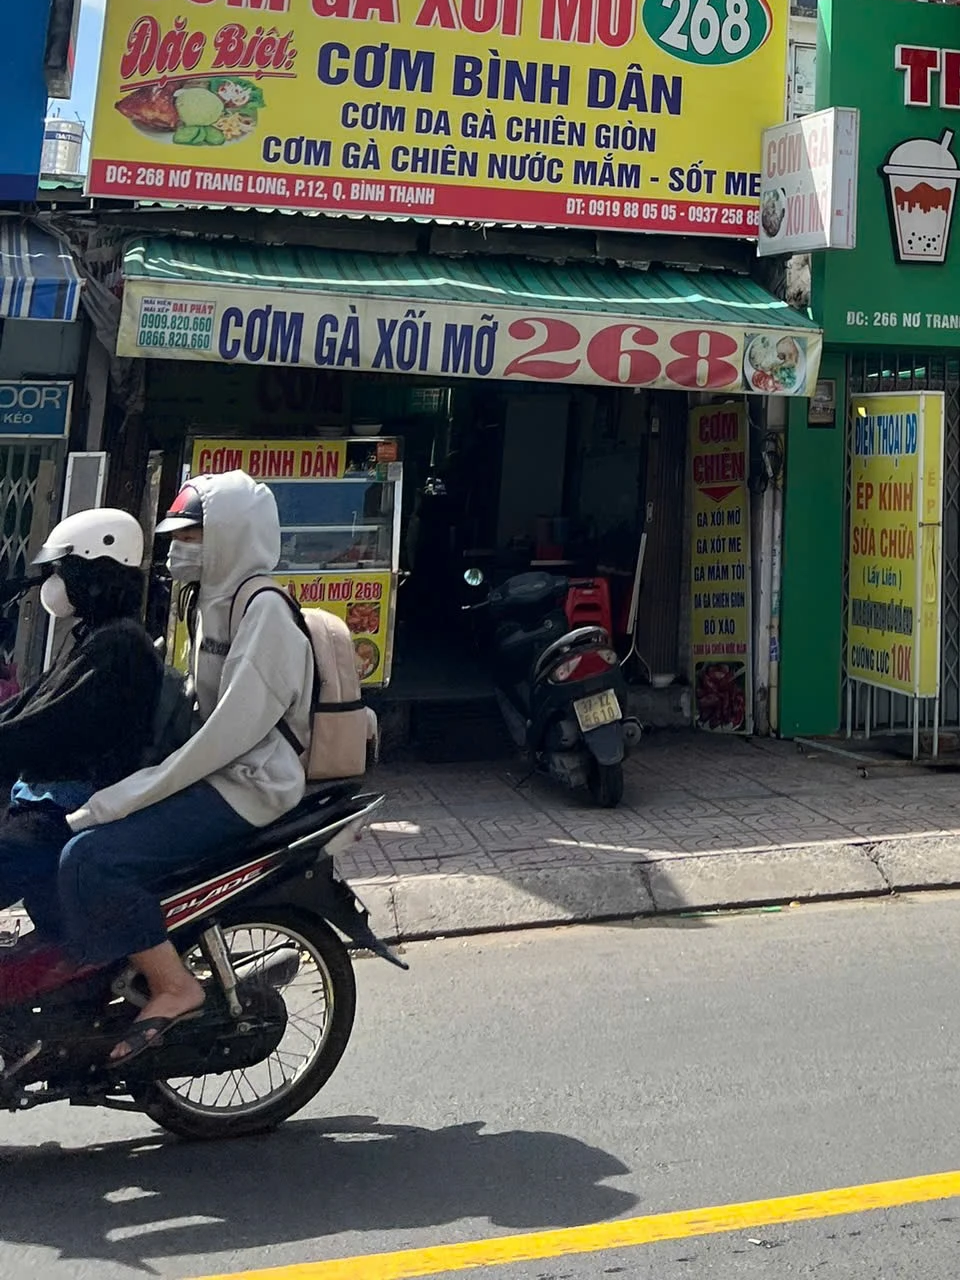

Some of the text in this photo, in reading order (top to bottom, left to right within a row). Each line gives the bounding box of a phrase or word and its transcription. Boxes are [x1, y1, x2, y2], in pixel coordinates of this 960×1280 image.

[317, 41, 682, 115] CƠM BÌNH DÂN
[341, 102, 656, 152] CƠM DA GÀ CHIÊN GIÒN
[262, 136, 331, 167] CƠM
[342, 138, 380, 170] GÀ
[391, 144, 478, 177] CHIÊN
[488, 150, 564, 184] NƯỚC
[573, 153, 641, 189] MẮM
[668, 160, 717, 194] SỐT
[725, 171, 761, 197] ME
[767, 118, 830, 179] CƠM GÀ
[106, 165, 435, 208] ĐC: 268 NƠ TRANG LONG, P.12, Q. BÌNH THẠNH
[566, 197, 585, 215] ĐT:
[588, 199, 620, 217] 0919
[623, 202, 639, 218] 88
[642, 203, 658, 220] 05
[661, 204, 676, 221] 05
[688, 205, 717, 224] 0937
[721, 208, 743, 225] 258
[141, 313, 212, 333] 0909.820.660
[847, 311, 869, 326] ĐC:
[873, 312, 897, 327] 266
[903, 311, 921, 328] NƠ
[218, 304, 738, 389] CƠM GÀ XỐI MỠ 268
[4, 411, 33, 424] KÉO
[699, 411, 739, 444] CƠM
[200, 447, 243, 474] CƠM
[248, 444, 295, 476] BÌNH
[301, 445, 339, 478] DÂN
[856, 475, 873, 511] ÉP
[879, 475, 913, 512] KÍNH
[728, 537, 742, 553] ME
[853, 518, 915, 560] SỬA CHỮA
[299, 578, 325, 601] XỐI
[328, 577, 354, 601] MỠ
[355, 582, 382, 600] 268
[891, 643, 911, 682] 10K
[166, 867, 263, 918] BLADE
